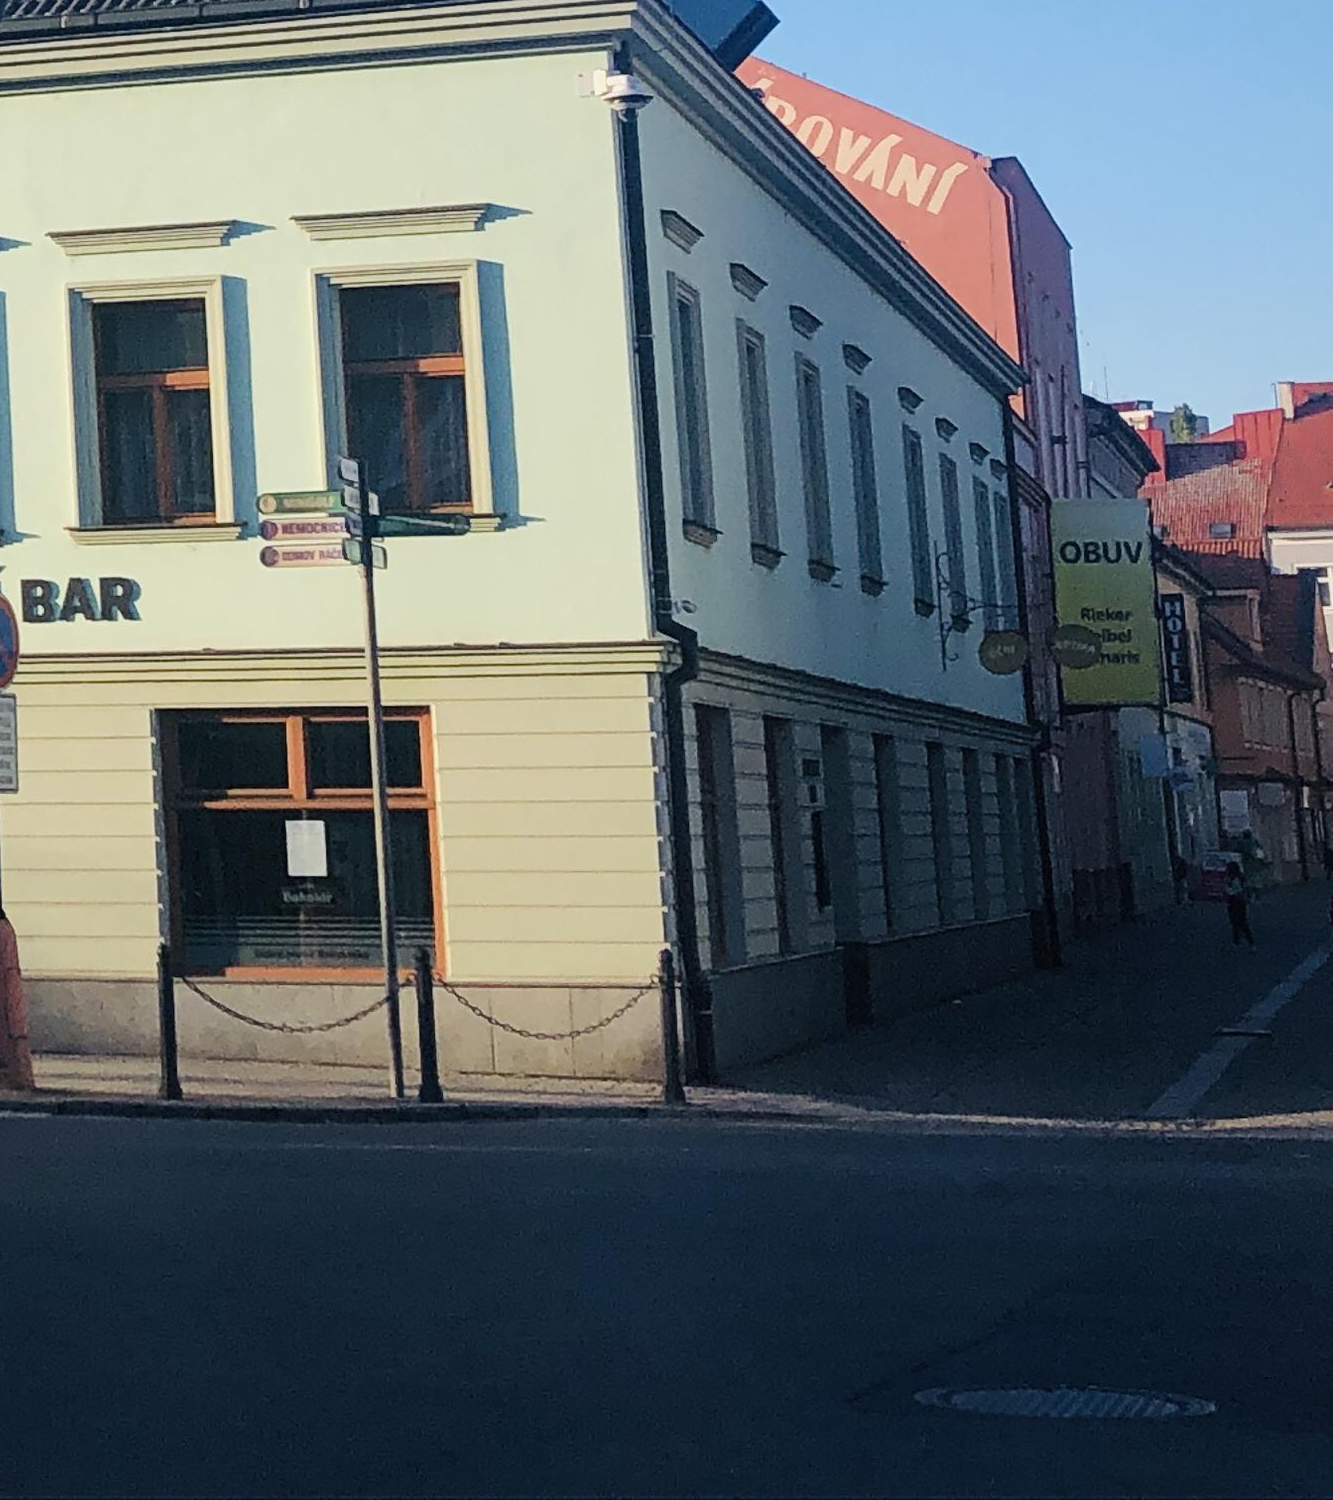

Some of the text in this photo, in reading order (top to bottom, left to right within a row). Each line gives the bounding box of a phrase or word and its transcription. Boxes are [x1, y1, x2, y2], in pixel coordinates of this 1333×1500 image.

[1059, 541, 1143, 564] OBUV
[21, 577, 143, 623] BAR
[1081, 607, 1133, 621] Rieker
[1164, 601, 1184, 685] HOTEL
